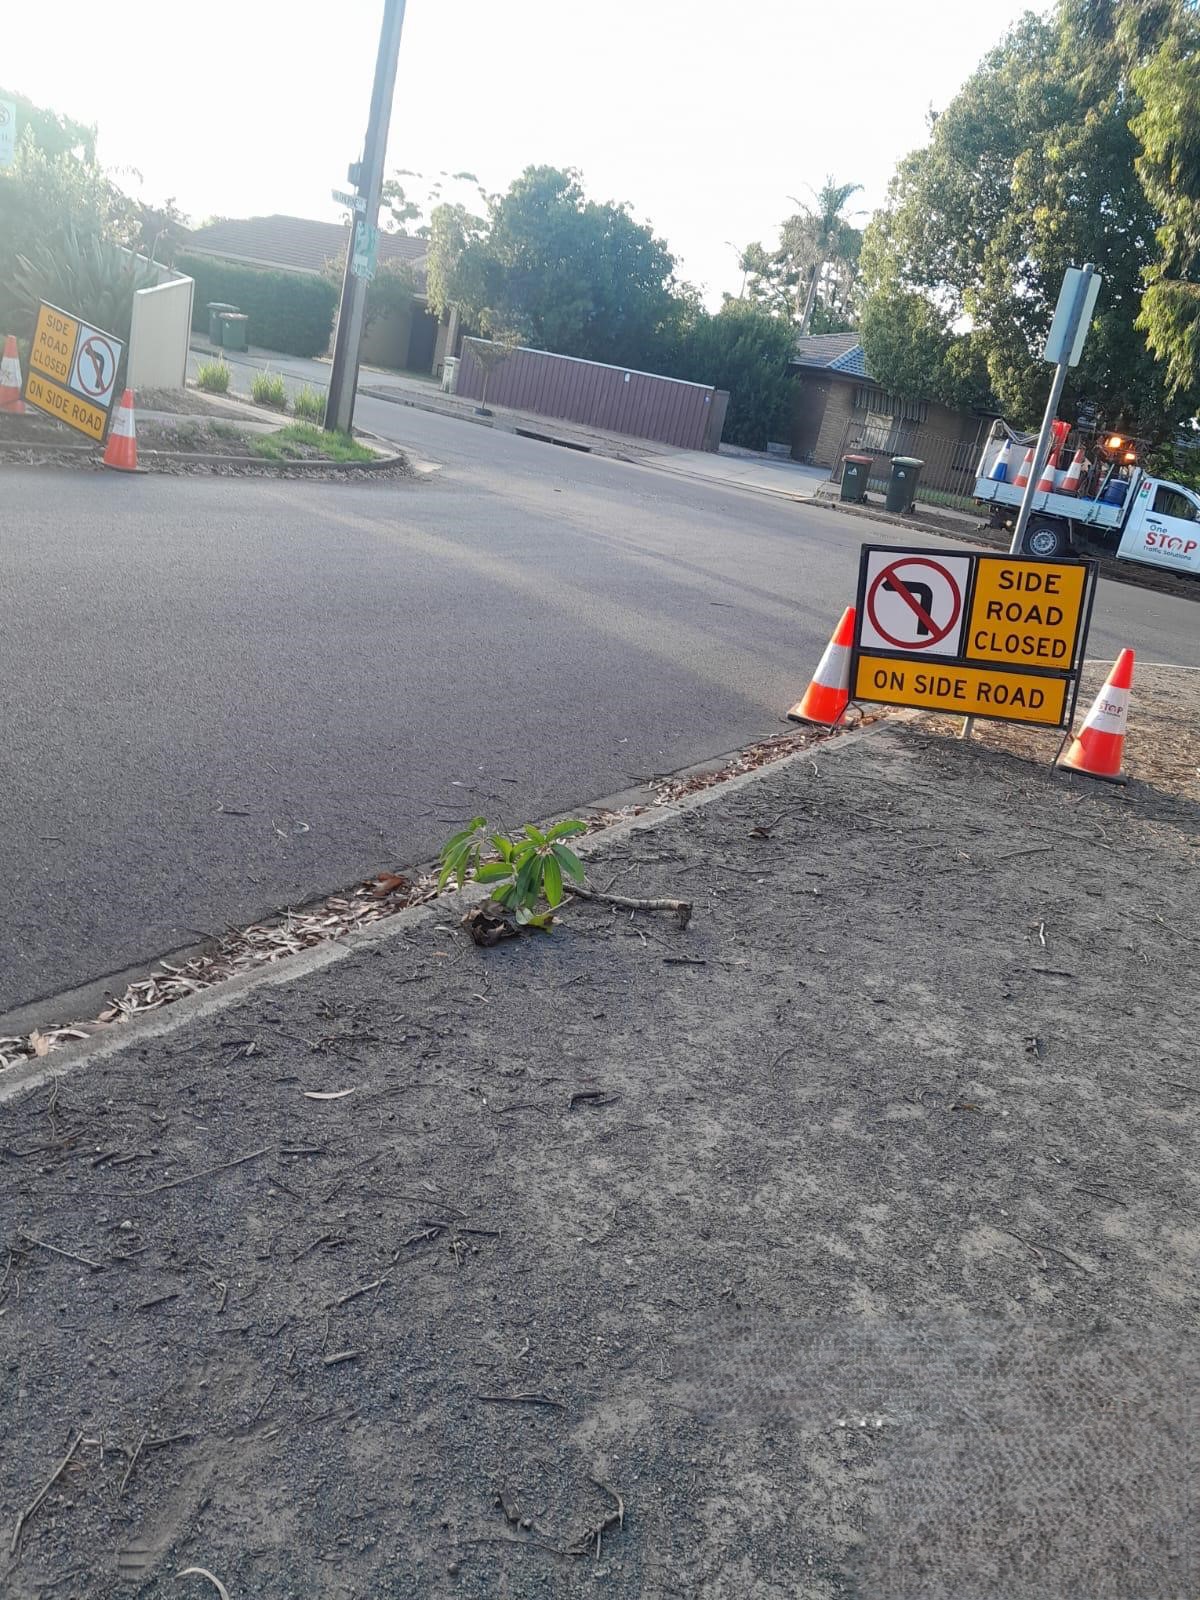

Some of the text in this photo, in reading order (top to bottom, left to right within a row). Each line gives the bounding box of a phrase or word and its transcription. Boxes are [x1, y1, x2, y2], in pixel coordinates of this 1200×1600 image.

[46, 315, 69, 336] SIDE
[39, 332, 69, 356] ROAD
[33, 349, 67, 378] CLOSED
[29, 380, 102, 432] ON SIDE ROAD
[1150, 524, 1168, 533] One
[1146, 532, 1197, 553] STOP
[998, 570, 1061, 595] SIDE
[986, 600, 1063, 626] ROAD
[974, 630, 1067, 659] CLOSED
[873, 669, 1045, 709] ON SIDE ROAD
